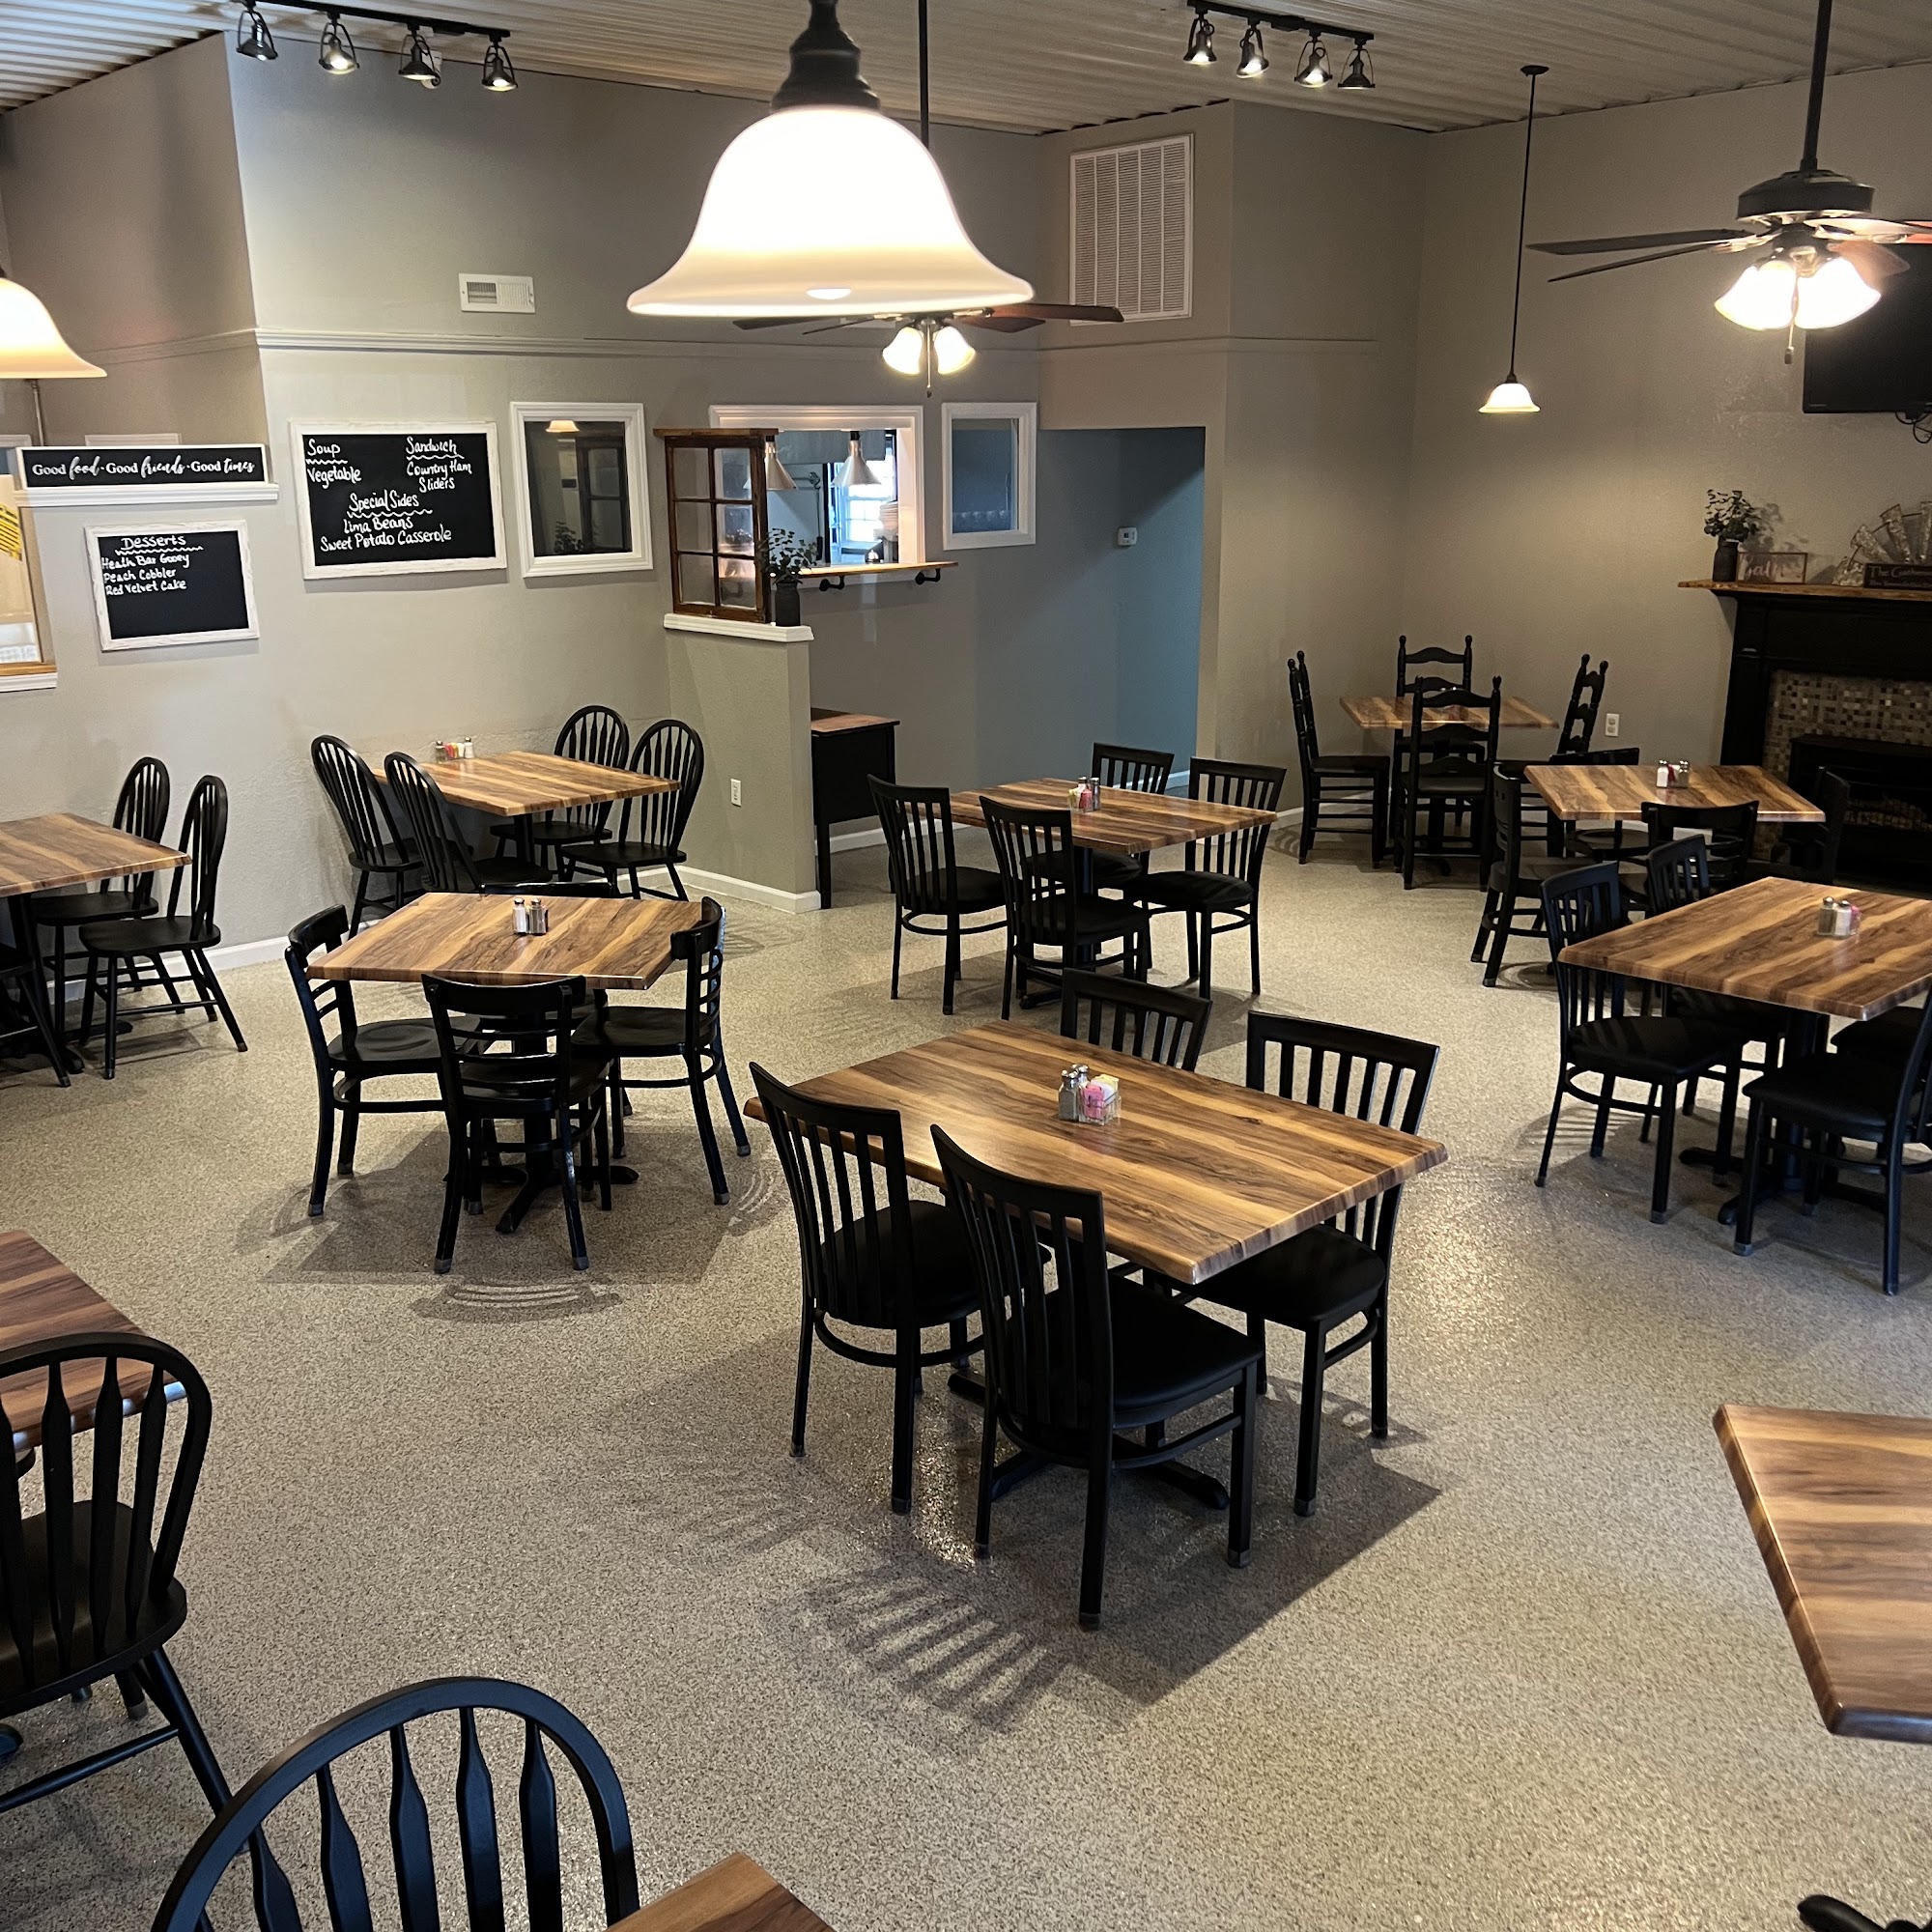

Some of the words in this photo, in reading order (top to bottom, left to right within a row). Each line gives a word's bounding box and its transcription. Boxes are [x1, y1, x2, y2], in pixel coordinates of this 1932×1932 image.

[307, 438, 341, 459] Soup
[406, 436, 458, 455] Sandwich
[32, 464, 67, 476] Good
[105, 462, 139, 474] Good
[190, 461, 222, 472] Good
[307, 465, 362, 490] Vegetable
[406, 461, 448, 481] Country
[449, 458, 472, 475] Ham
[418, 476, 456, 494] Sliders
[349, 489, 391, 513] Special
[389, 489, 419, 509] Sides
[343, 518, 372, 534] Lima
[372, 516, 413, 530] Beans
[120, 534, 187, 551] Desserts
[320, 535, 354, 553] Sweet
[354, 530, 395, 549] Potato
[397, 523, 452, 546] Casserole
[100, 555, 136, 570] Heath
[135, 554, 156, 566] Bar
[159, 553, 190, 569] Gooey
[102, 569, 137, 584] Peach
[138, 566, 177, 581] Cobbler
[104, 583, 125, 596] Red
[124, 580, 159, 594] Velvet
[159, 579, 187, 592] Cake
